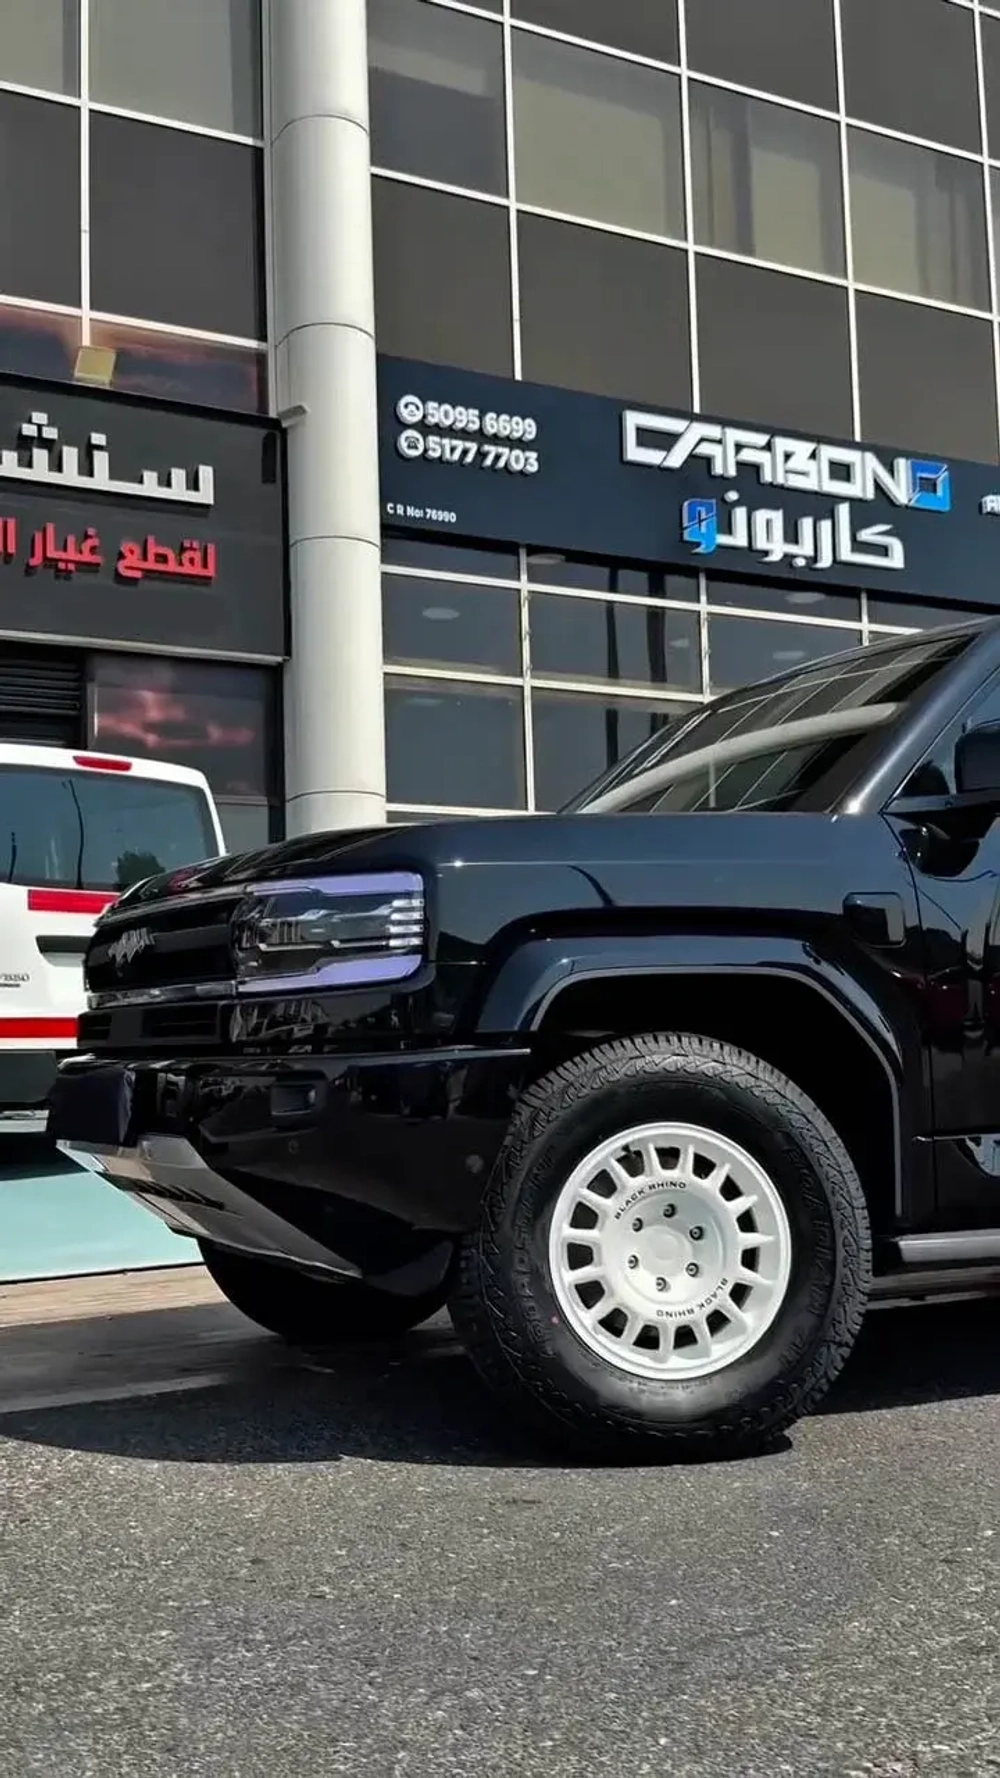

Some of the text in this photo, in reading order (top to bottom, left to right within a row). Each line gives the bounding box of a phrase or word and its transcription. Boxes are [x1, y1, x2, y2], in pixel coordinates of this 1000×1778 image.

[425, 401, 537, 442] 5095 6699
[0, 412, 214, 505] سنش
[425, 435, 539, 474] 5177 7703
[386, 503, 394, 514] C
[29, 522, 104, 572] غيار
[683, 490, 904, 569] كاربونو
[117, 534, 216, 579] لقطع
[614, 1181, 686, 1220] BLACK RHINO
[656, 1278, 728, 1318] BLACK RHINO
